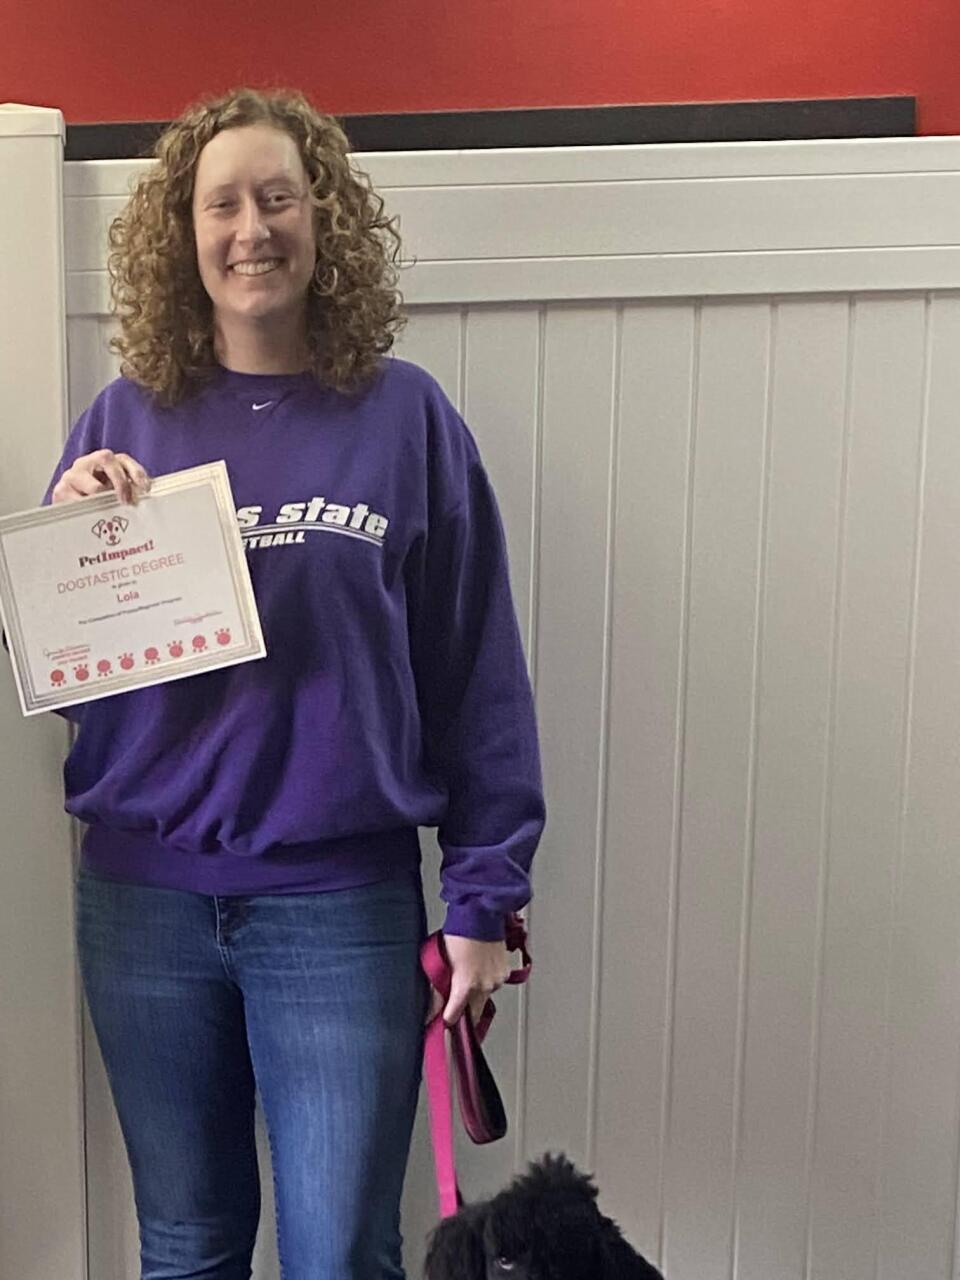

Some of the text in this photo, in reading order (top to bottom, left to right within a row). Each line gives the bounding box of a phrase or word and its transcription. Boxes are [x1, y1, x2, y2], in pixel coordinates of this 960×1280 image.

[276, 496, 389, 538] state
[78, 540, 155, 568] PetImpact!
[56, 552, 185, 594] DOGTASTIC DEGREE
[116, 590, 140, 603] Lola
